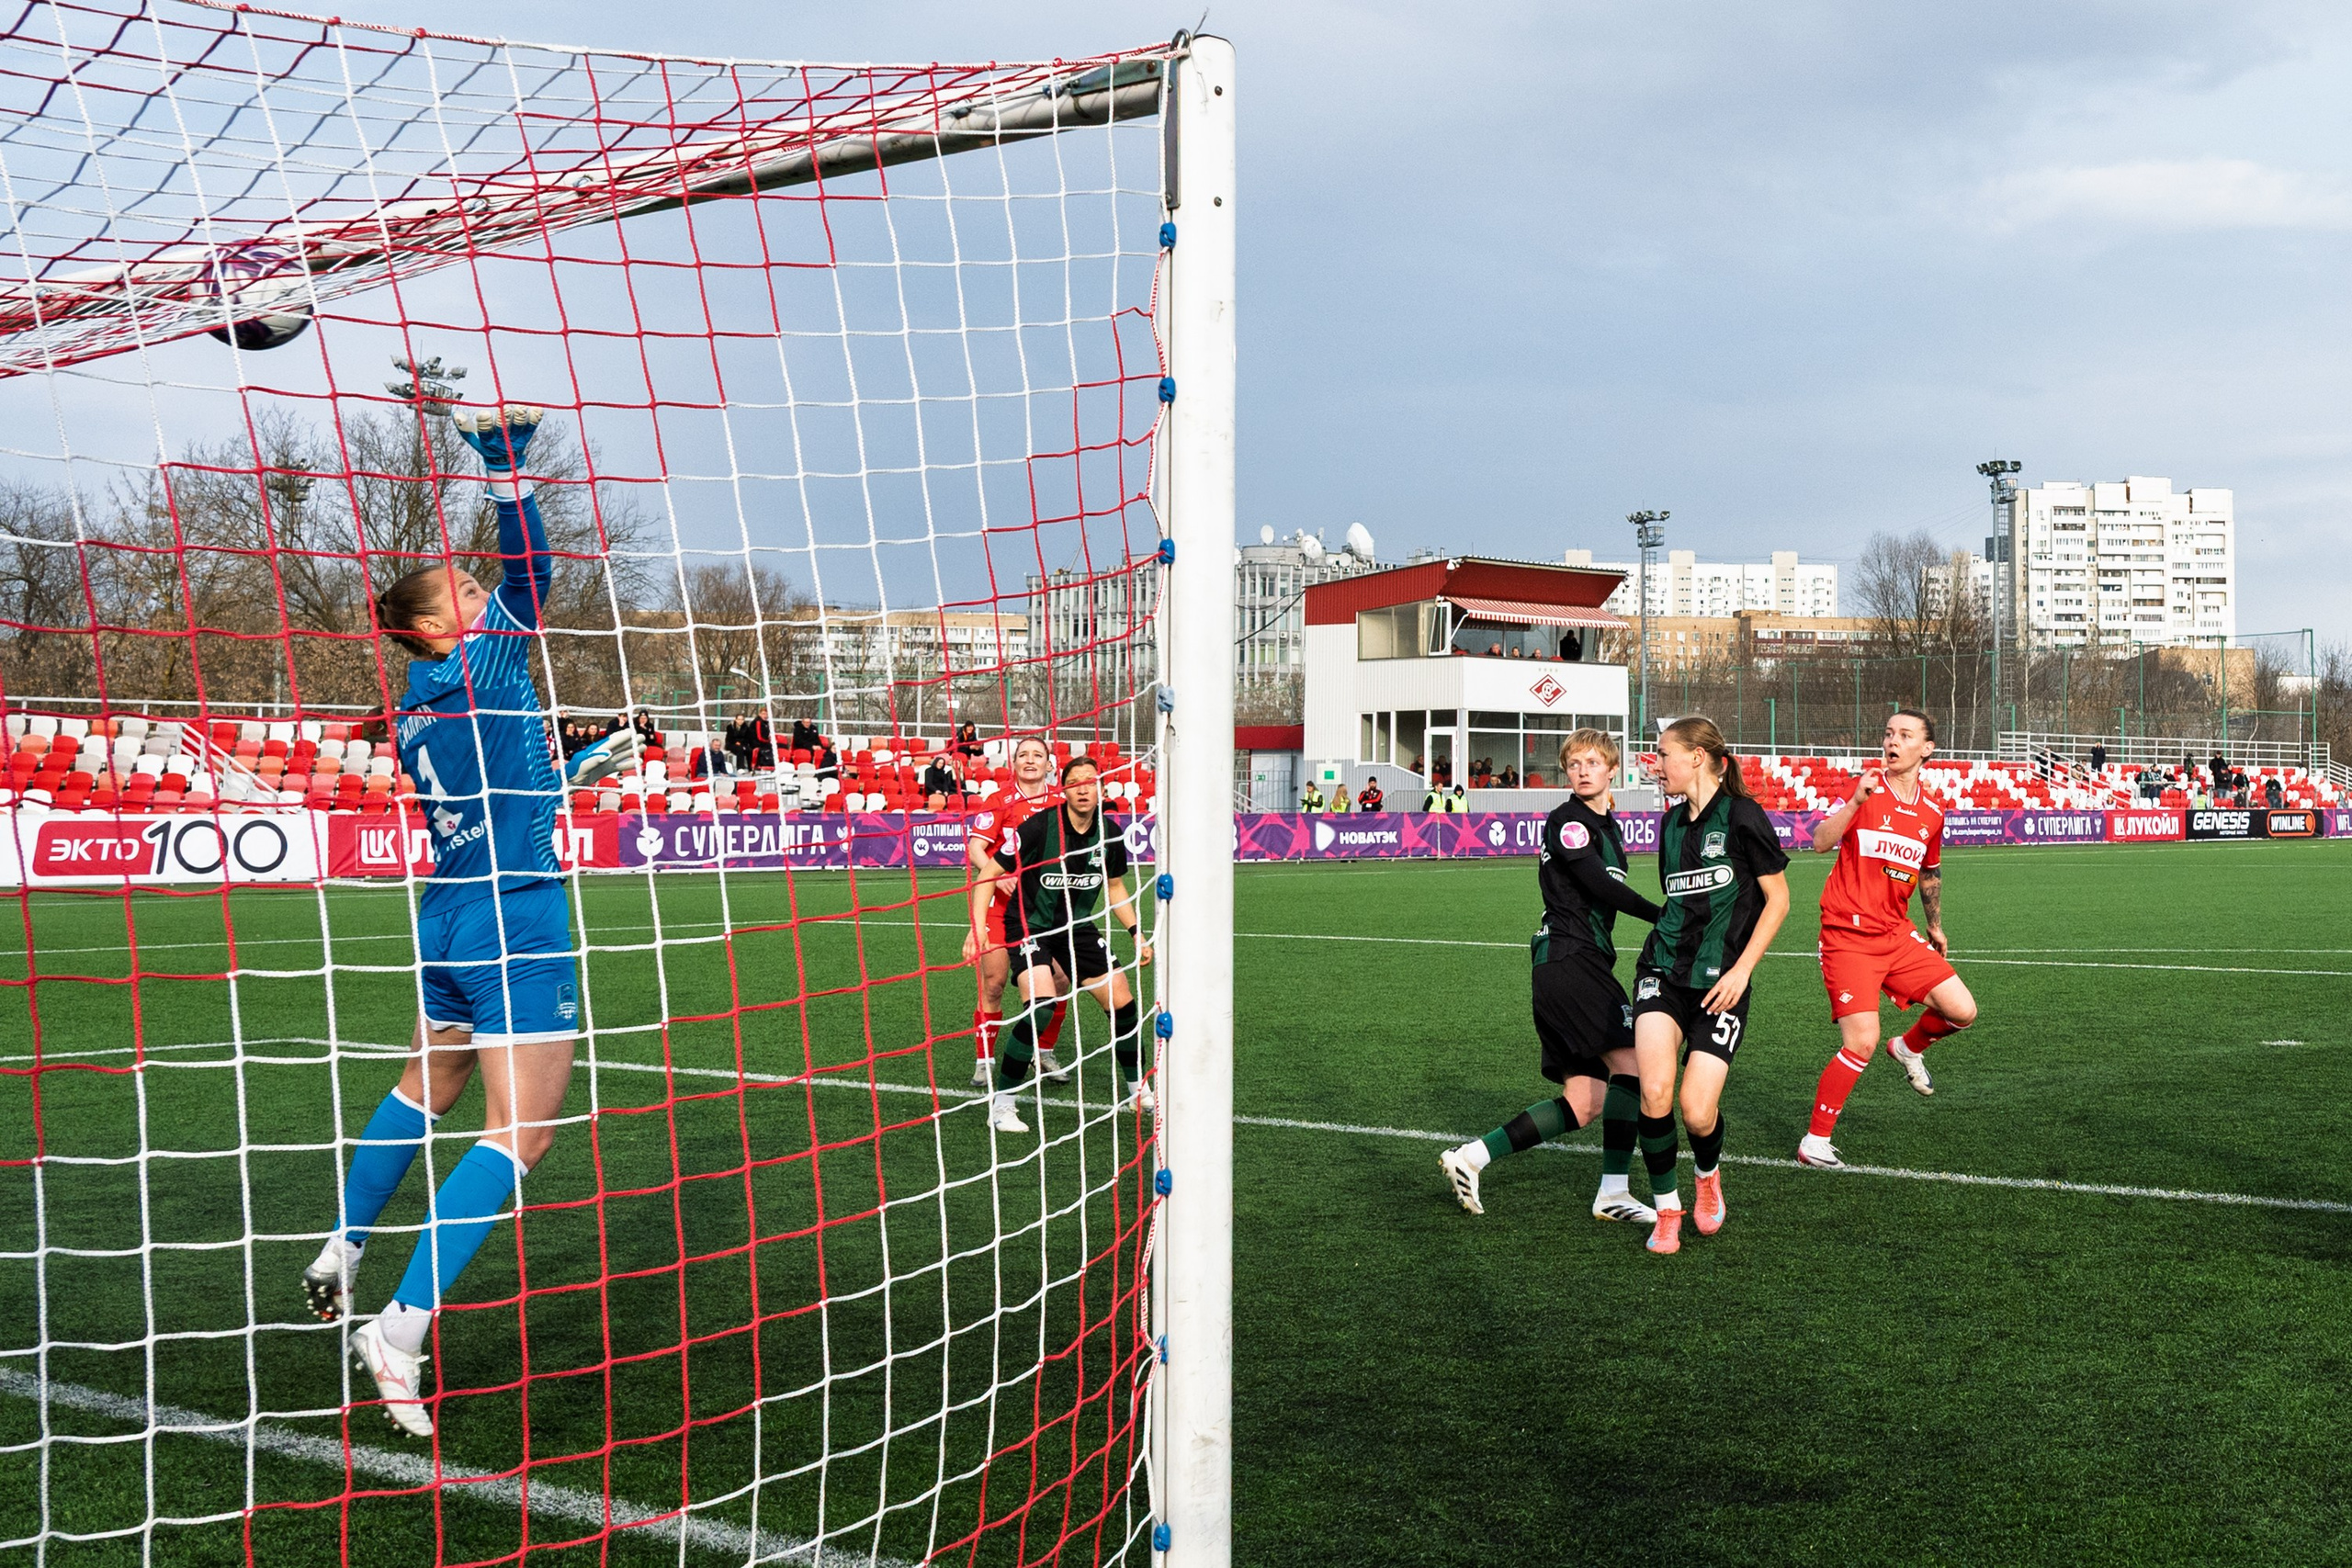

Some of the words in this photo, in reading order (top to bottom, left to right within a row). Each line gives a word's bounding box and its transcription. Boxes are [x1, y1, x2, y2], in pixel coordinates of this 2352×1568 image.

[913, 824, 972, 837] ПОДПИШИЬ
[2038, 817, 2092, 836] СУПЕРЛИГА
[2126, 812, 2179, 835] ЛУКОЙЛ
[2192, 812, 2251, 830] GENESIS
[2270, 816, 2305, 831] WINLINE
[49, 838, 141, 863] ЭКТО
[147, 819, 288, 874] 100
[675, 825, 827, 857] СУПЕРЛИГА
[1340, 831, 1398, 844] НОВАТЭК
[1875, 840, 1925, 864] ЛУКОЙ
[1046, 875, 1091, 887] WINLINE
[1668, 873, 1713, 892] WINLINE
